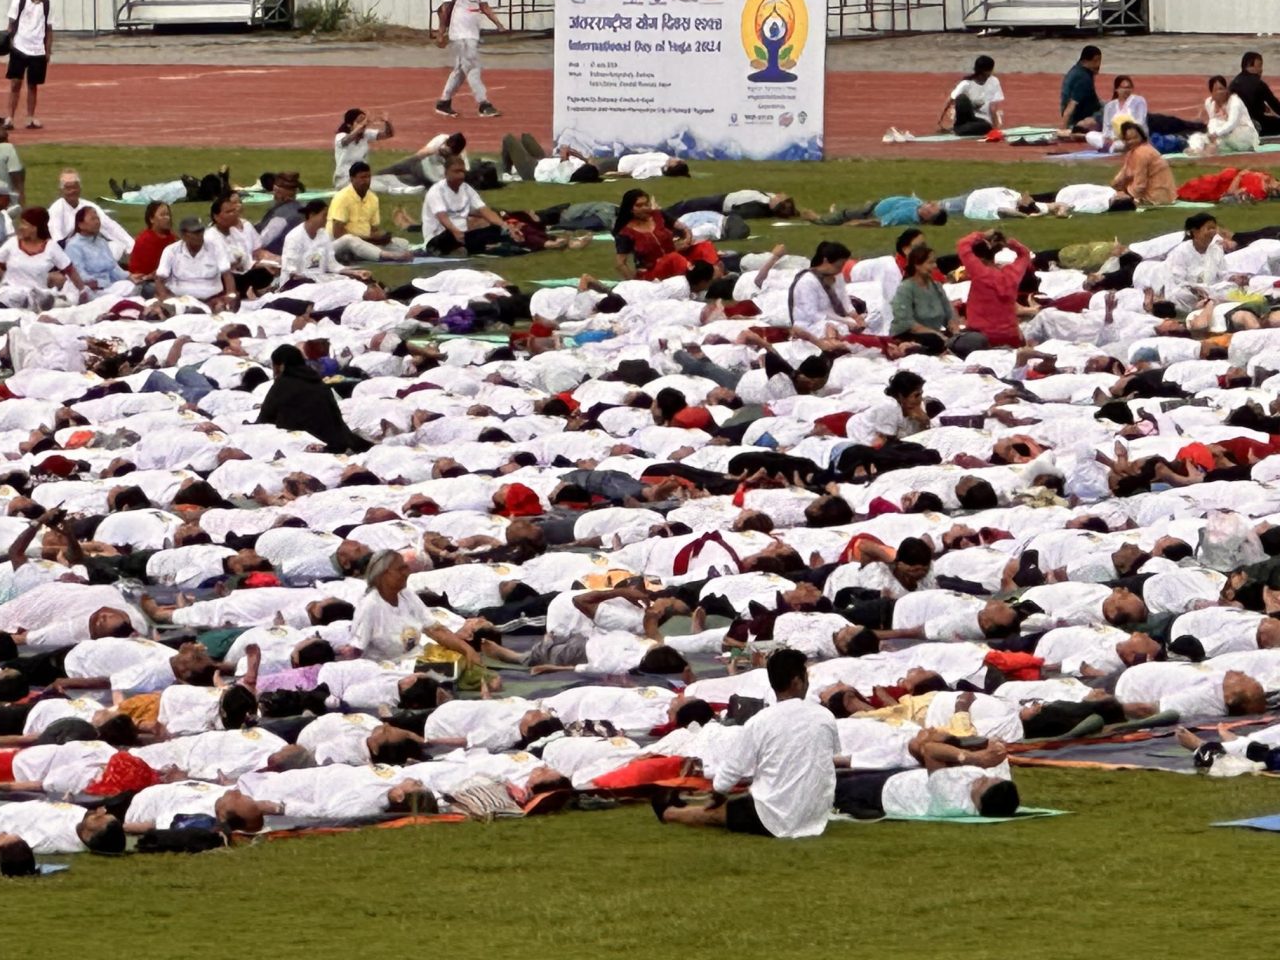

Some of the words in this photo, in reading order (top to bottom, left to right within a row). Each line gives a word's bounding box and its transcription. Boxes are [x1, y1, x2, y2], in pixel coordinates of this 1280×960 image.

[569, 39, 631, 52] International
[634, 40, 652, 53] Day
[655, 40, 665, 52] of
[668, 40, 692, 54] Yoga
